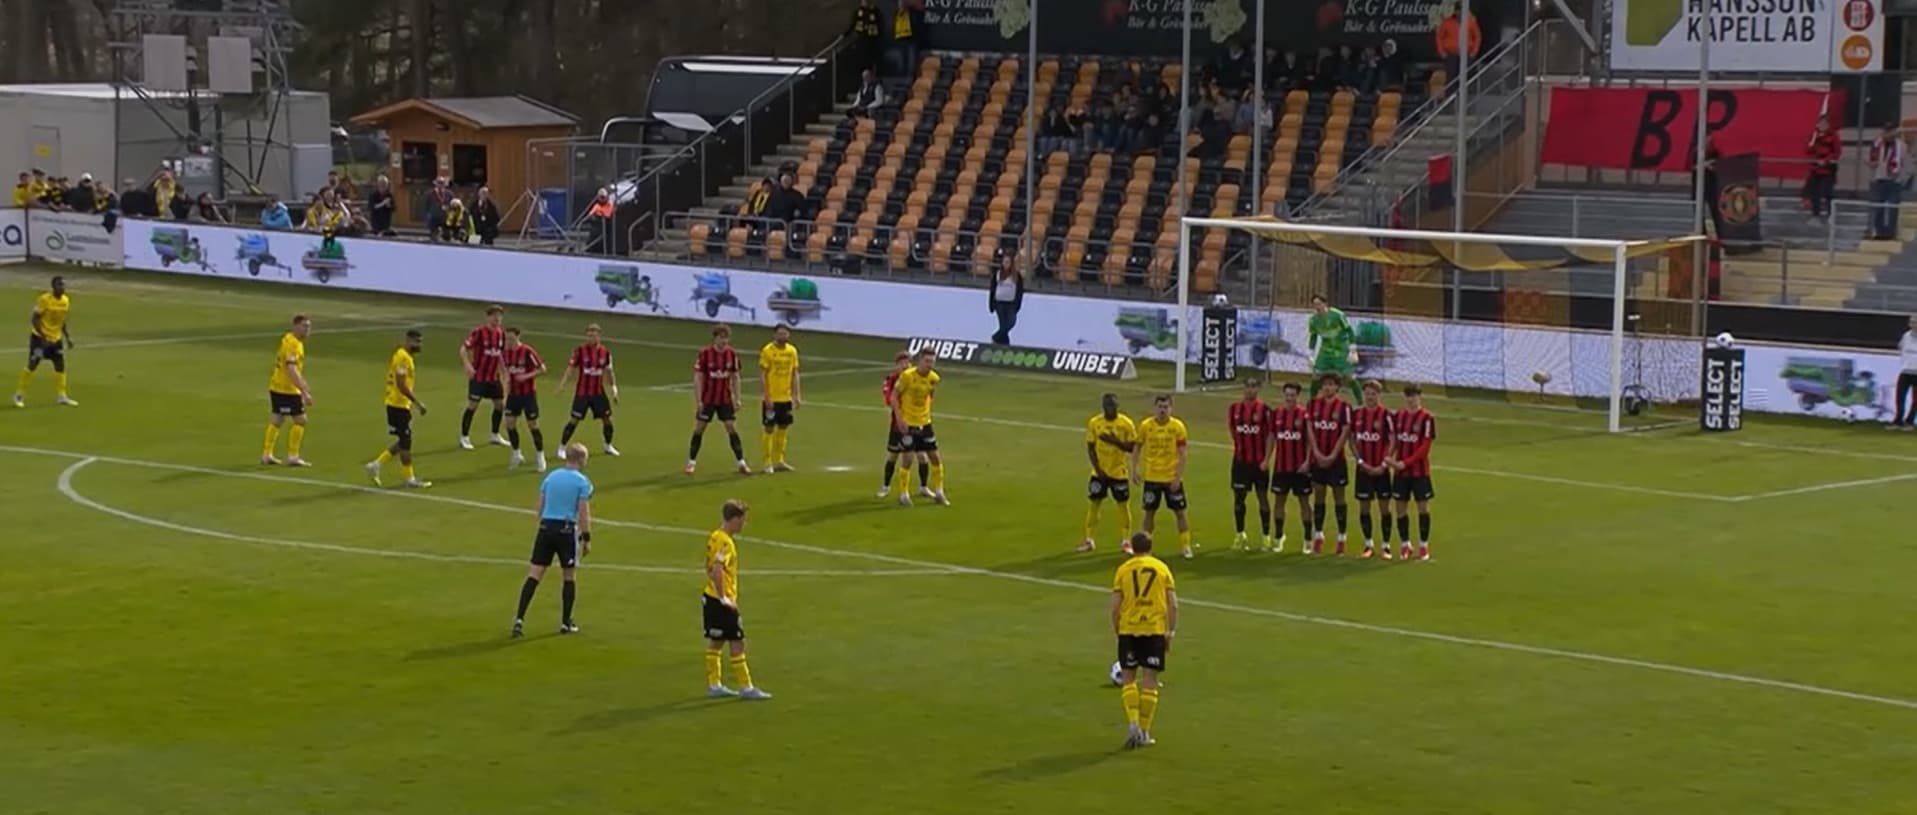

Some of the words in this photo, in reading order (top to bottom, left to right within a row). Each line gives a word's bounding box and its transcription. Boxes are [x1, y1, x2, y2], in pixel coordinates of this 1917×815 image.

[1345, 0, 1378, 16] K-G
[1687, 16, 1775, 42] KAPELL
[1782, 16, 1815, 42] AB
[909, 338, 979, 361] UNIBET
[1053, 351, 1125, 374] UNIBET
[1205, 317, 1220, 379] SELECT
[1225, 319, 1235, 379] SELECT
[1706, 359, 1725, 429] SELECT
[1729, 360, 1743, 430] SELECT
[1132, 567, 1157, 597] 17
